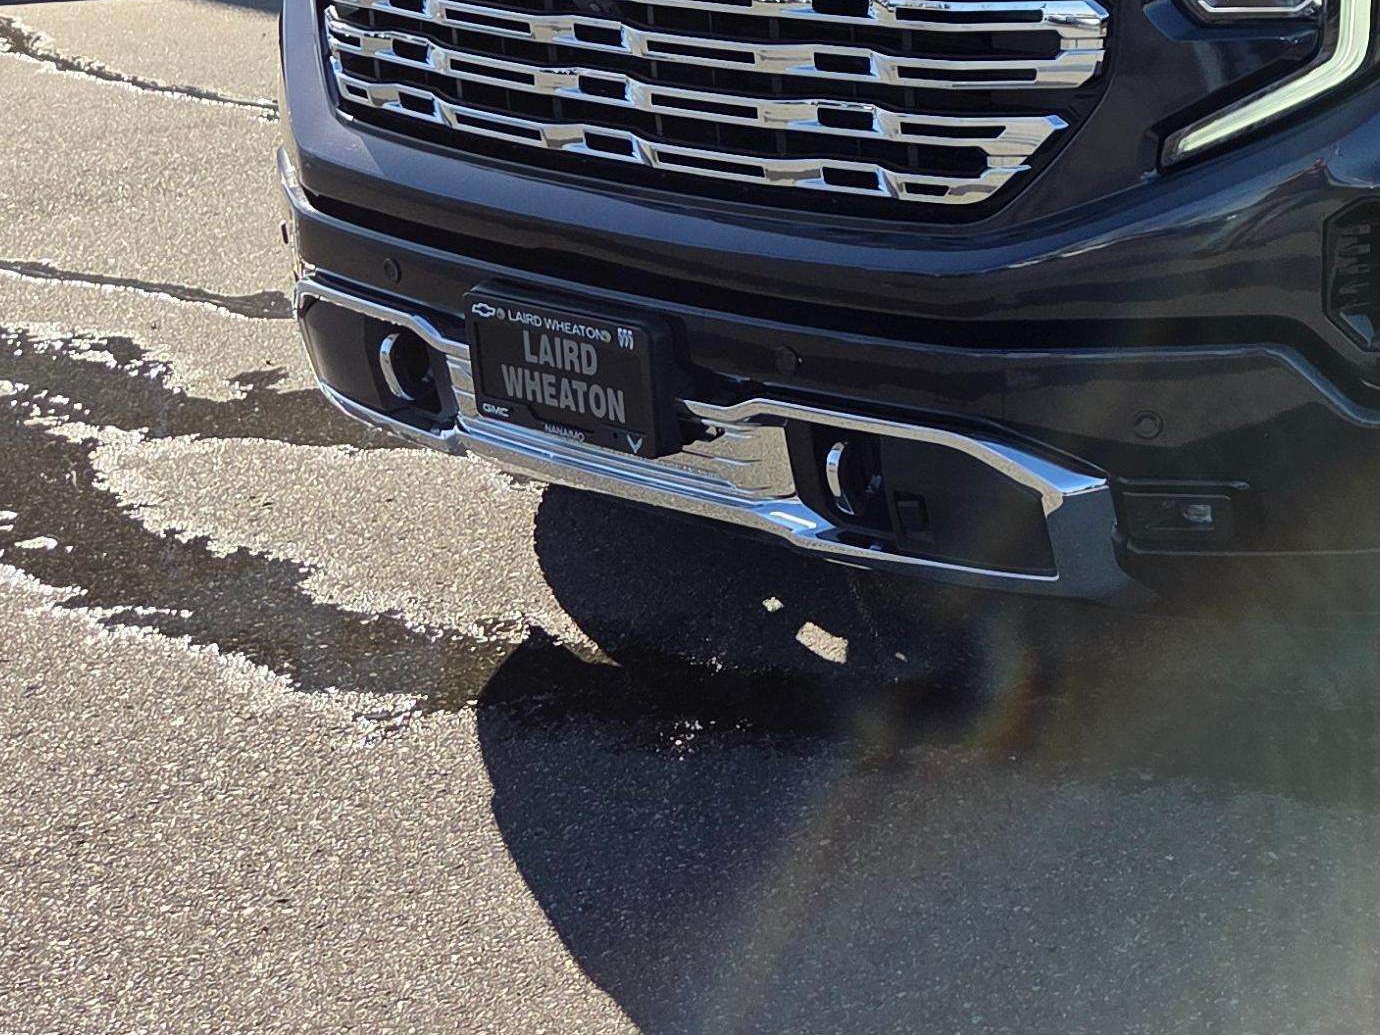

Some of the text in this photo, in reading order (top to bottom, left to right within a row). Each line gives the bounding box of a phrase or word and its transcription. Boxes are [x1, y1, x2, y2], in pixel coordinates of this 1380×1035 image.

[507, 309, 606, 341] LAIRD WHEATON
[523, 330, 598, 376] LAIRD
[482, 402, 510, 418] GMC
[501, 364, 626, 424] WHEATON
